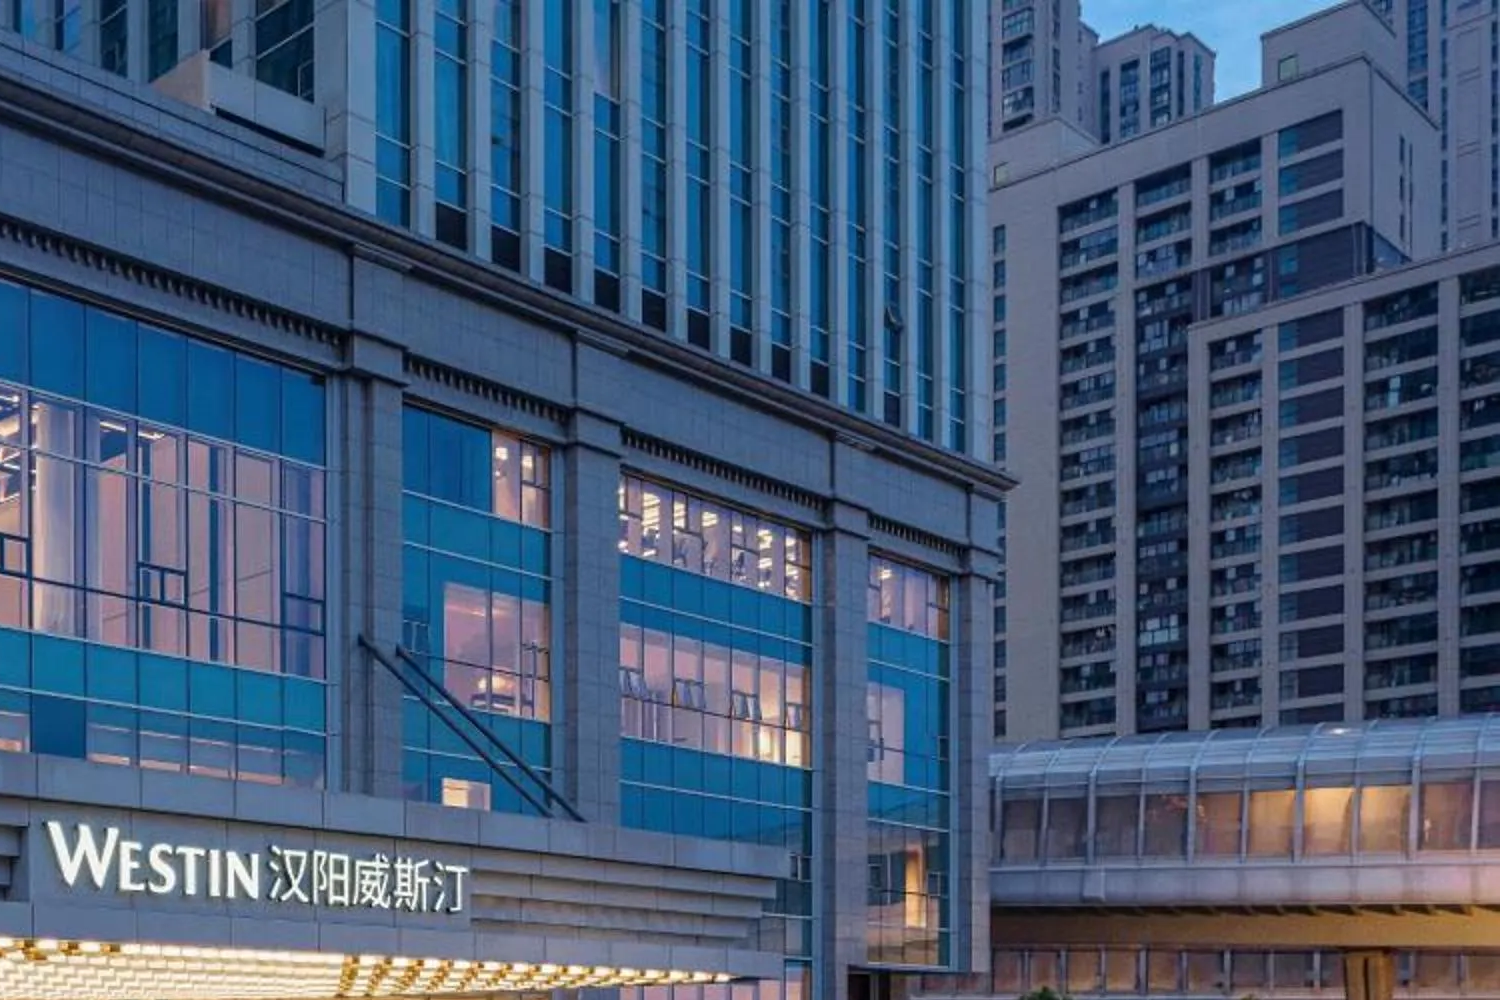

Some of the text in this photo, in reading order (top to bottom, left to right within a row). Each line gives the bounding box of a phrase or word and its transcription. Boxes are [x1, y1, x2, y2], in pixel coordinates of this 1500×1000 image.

[47, 820, 469, 913] WESTIN 汉阳威斯汀
